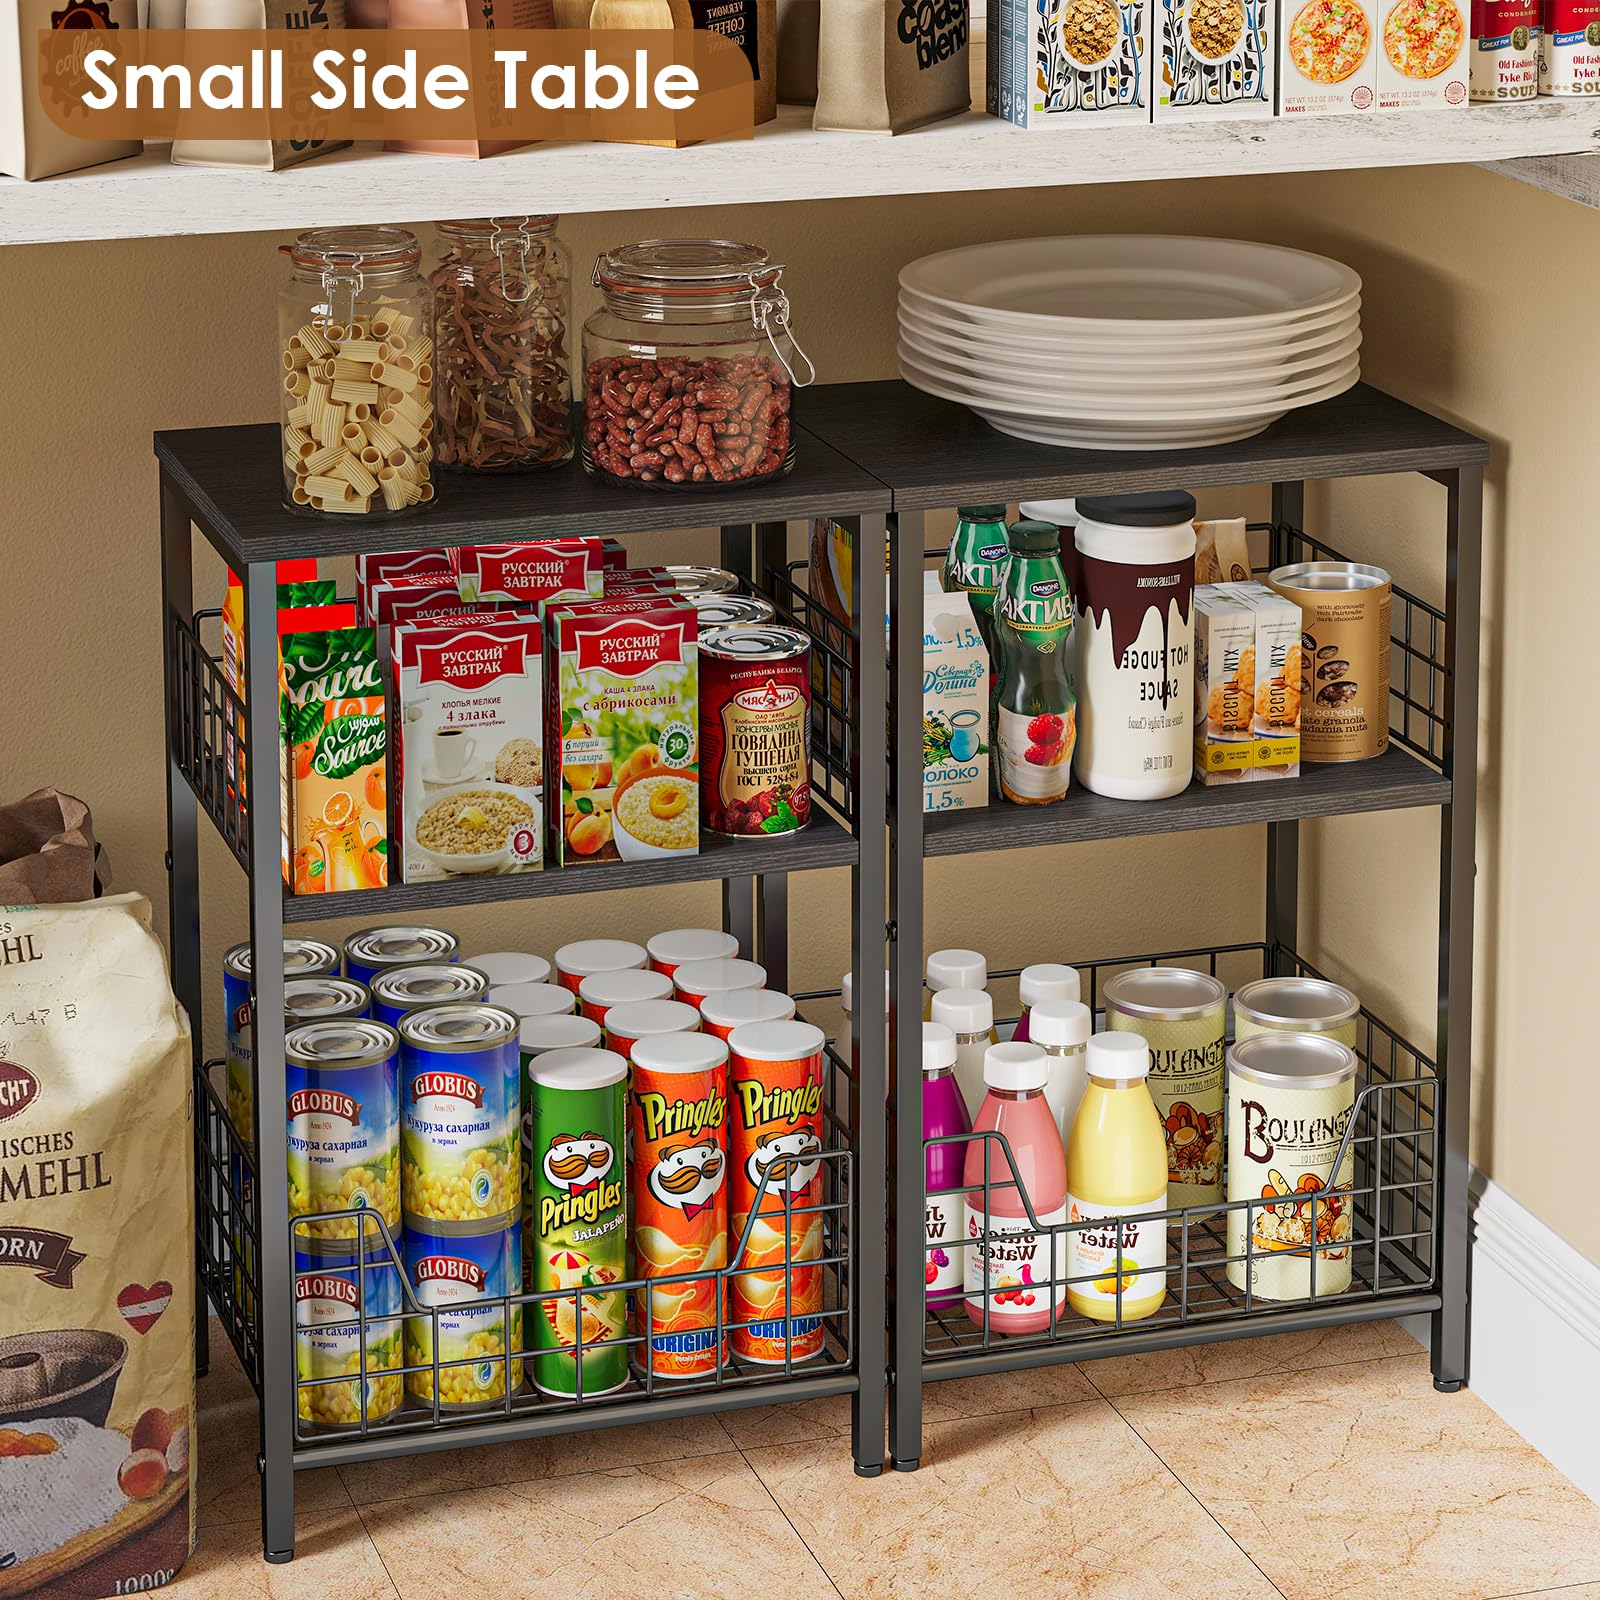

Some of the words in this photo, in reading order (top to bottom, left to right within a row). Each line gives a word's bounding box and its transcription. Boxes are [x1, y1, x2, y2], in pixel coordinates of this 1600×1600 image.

[914, 16, 969, 71] blend
[1498, 60, 1510, 70] Old
[1573, 56, 1584, 65] Old
[1498, 72, 1521, 85] Tyke
[1573, 68, 1596, 80] Tyke
[1497, 85, 1535, 98] SOUP
[501, 559, 564, 575] РУССКИЙ
[503, 576, 563, 588] ЗАВТРАК
[600, 633, 660, 651] РУССКИЙ
[440, 646, 503, 665] РУССКИЙ
[601, 648, 659, 664] ЗАВТРАК
[442, 662, 502, 678] ЗАВТРАК
[604, 687, 625, 695] КАША
[633, 684, 656, 693] ЗЛАКА
[441, 699, 471, 709] ХЛОПЬЯ
[473, 697, 502, 706] МЕЛКИЕ
[583, 702, 589, 711] с
[593, 695, 677, 713] абрикосами
[446, 710, 454, 722] 4
[457, 708, 497, 721] злака
[1314, 707, 1364, 718] cereals
[1322, 716, 1366, 727] granola
[1345, 723, 1368, 732] nuts
[565, 740, 571, 750] 6
[572, 739, 600, 752] порций
[732, 730, 802, 751] ГОВЯДИНА
[314, 729, 386, 776] Source
[734, 745, 800, 766] ТУШЕНАЯ
[737, 775, 763, 786] ГОСТ
[923, 766, 979, 783] ОЛОКО
[518, 833, 529, 852] 3
[415, 1074, 478, 1100] GLOBUS
[291, 1092, 354, 1118] GLOBUS
[736, 1075, 823, 1129] Pringles
[638, 1088, 727, 1140] Pringles
[407, 1113, 444, 1134] Кукуруза
[445, 1121, 491, 1135] сахарная
[286, 1135, 321, 1151] укуруза
[322, 1138, 368, 1153] сахарная
[0, 1151, 112, 1202] MEHL
[540, 1179, 623, 1239] Pringles
[572, 1212, 625, 1242] JALAPEÑO
[417, 1259, 479, 1283] GLOBUS
[295, 1278, 357, 1302] GLOBUS
